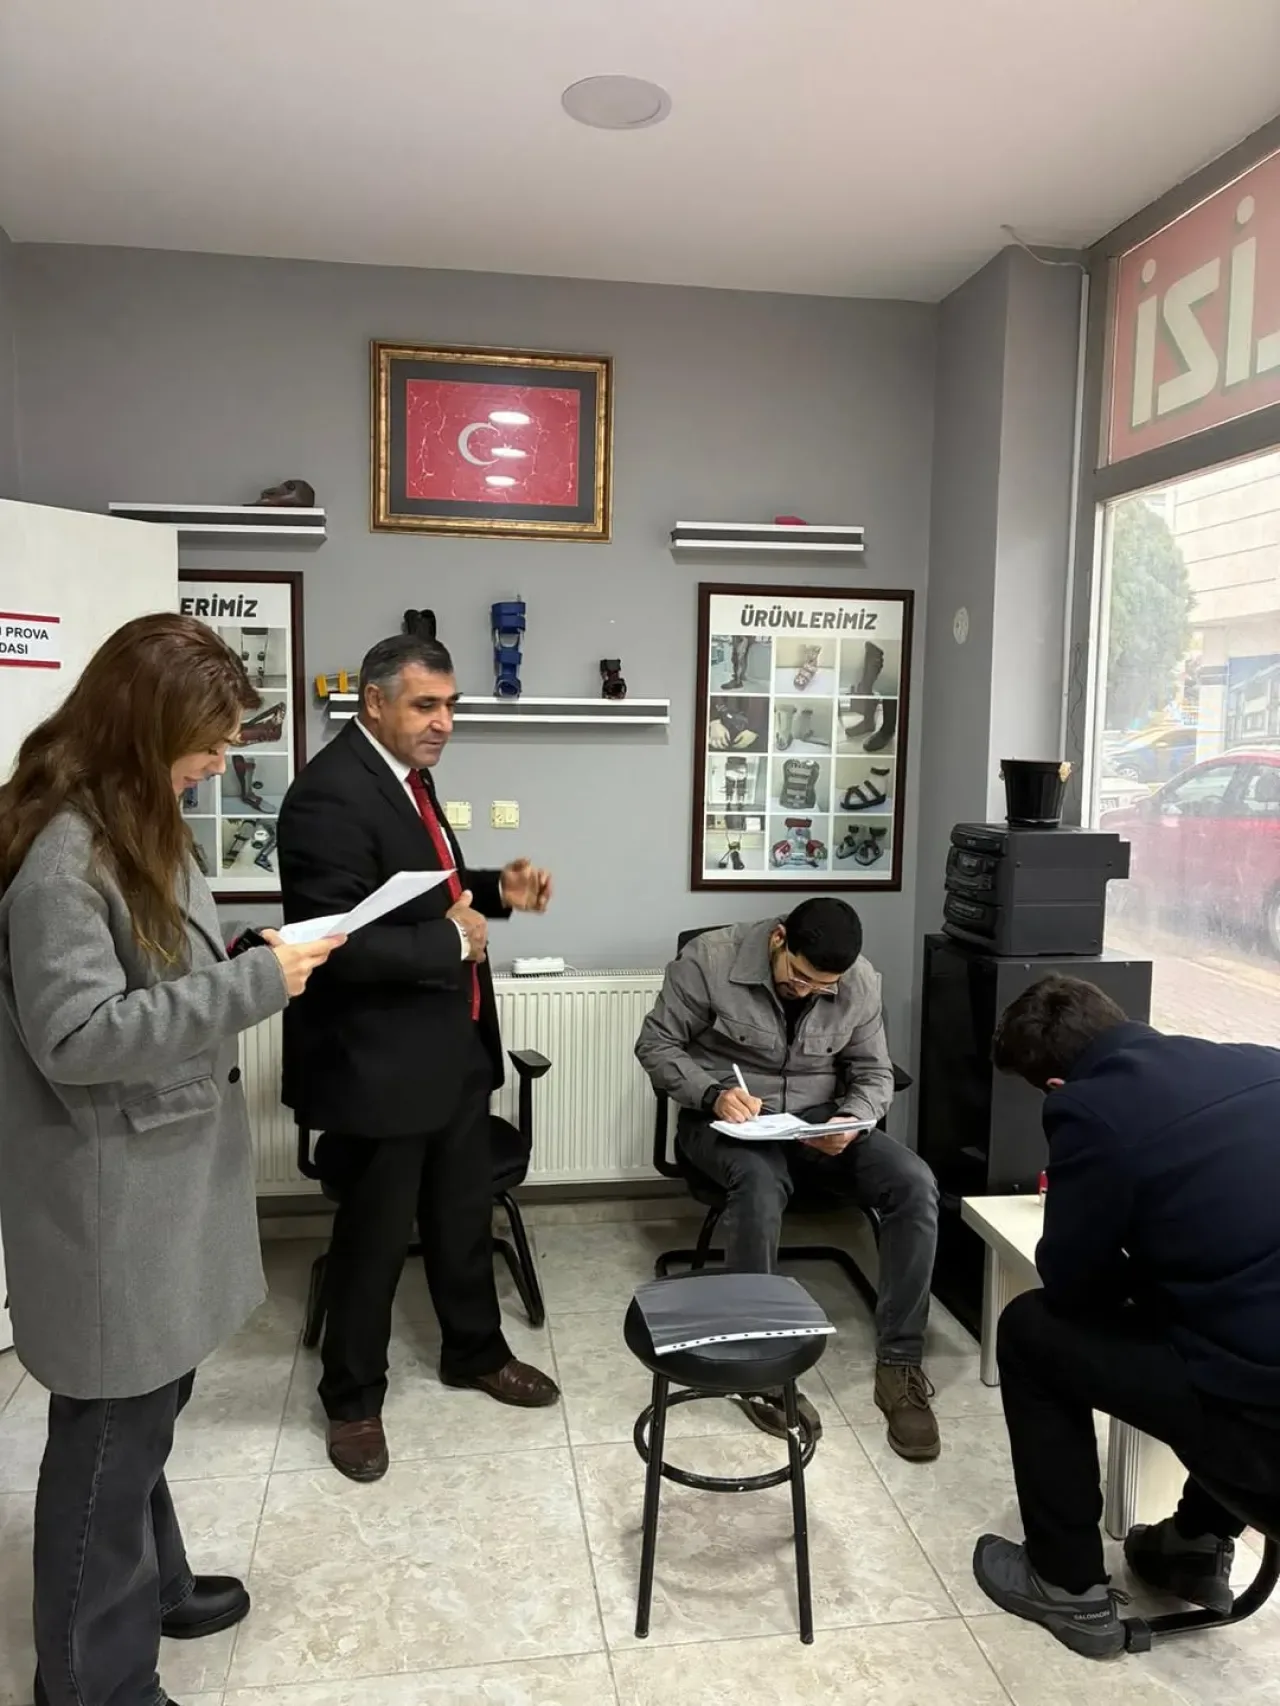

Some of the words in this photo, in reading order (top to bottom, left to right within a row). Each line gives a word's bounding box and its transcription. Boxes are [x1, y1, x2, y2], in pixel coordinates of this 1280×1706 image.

[180, 593, 258, 618] ERİMİZ
[740, 603, 878, 631] ÜRÜNLERİMİZ
[5, 626, 49, 640] PROVA
